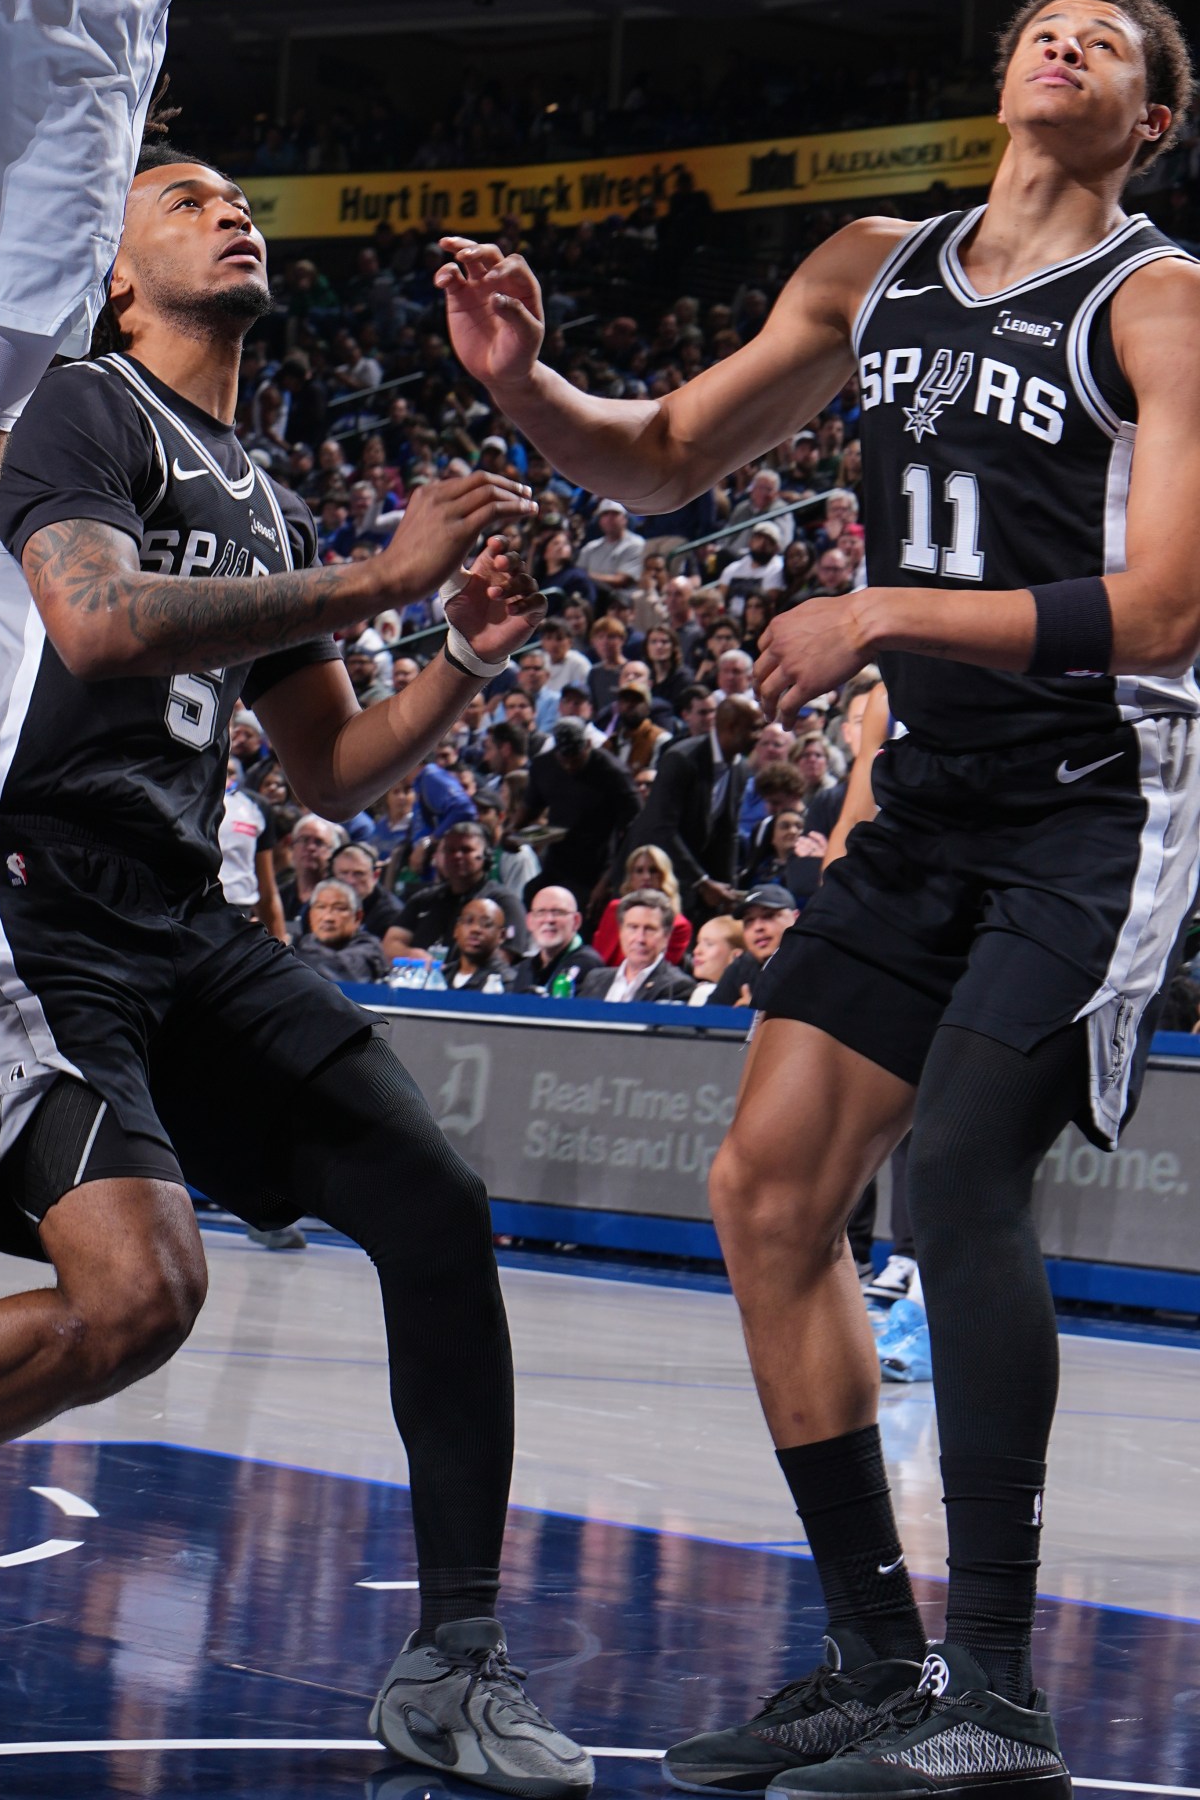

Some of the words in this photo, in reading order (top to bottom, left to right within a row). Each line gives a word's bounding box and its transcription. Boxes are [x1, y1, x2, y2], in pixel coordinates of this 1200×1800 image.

[340, 184, 412, 221] Hurt
[421, 181, 449, 218] in
[459, 188, 478, 216] a
[486, 173, 570, 214] Truck
[1003, 317, 1052, 339] LEDGER
[859, 347, 1067, 445] SPURS
[899, 462, 984, 582] 11
[164, 667, 225, 752] 5
[528, 1069, 689, 1122] Real-Time
[522, 1119, 608, 1166] Stats
[609, 1129, 673, 1172] and
[1033, 1127, 1190, 1196] Home.
